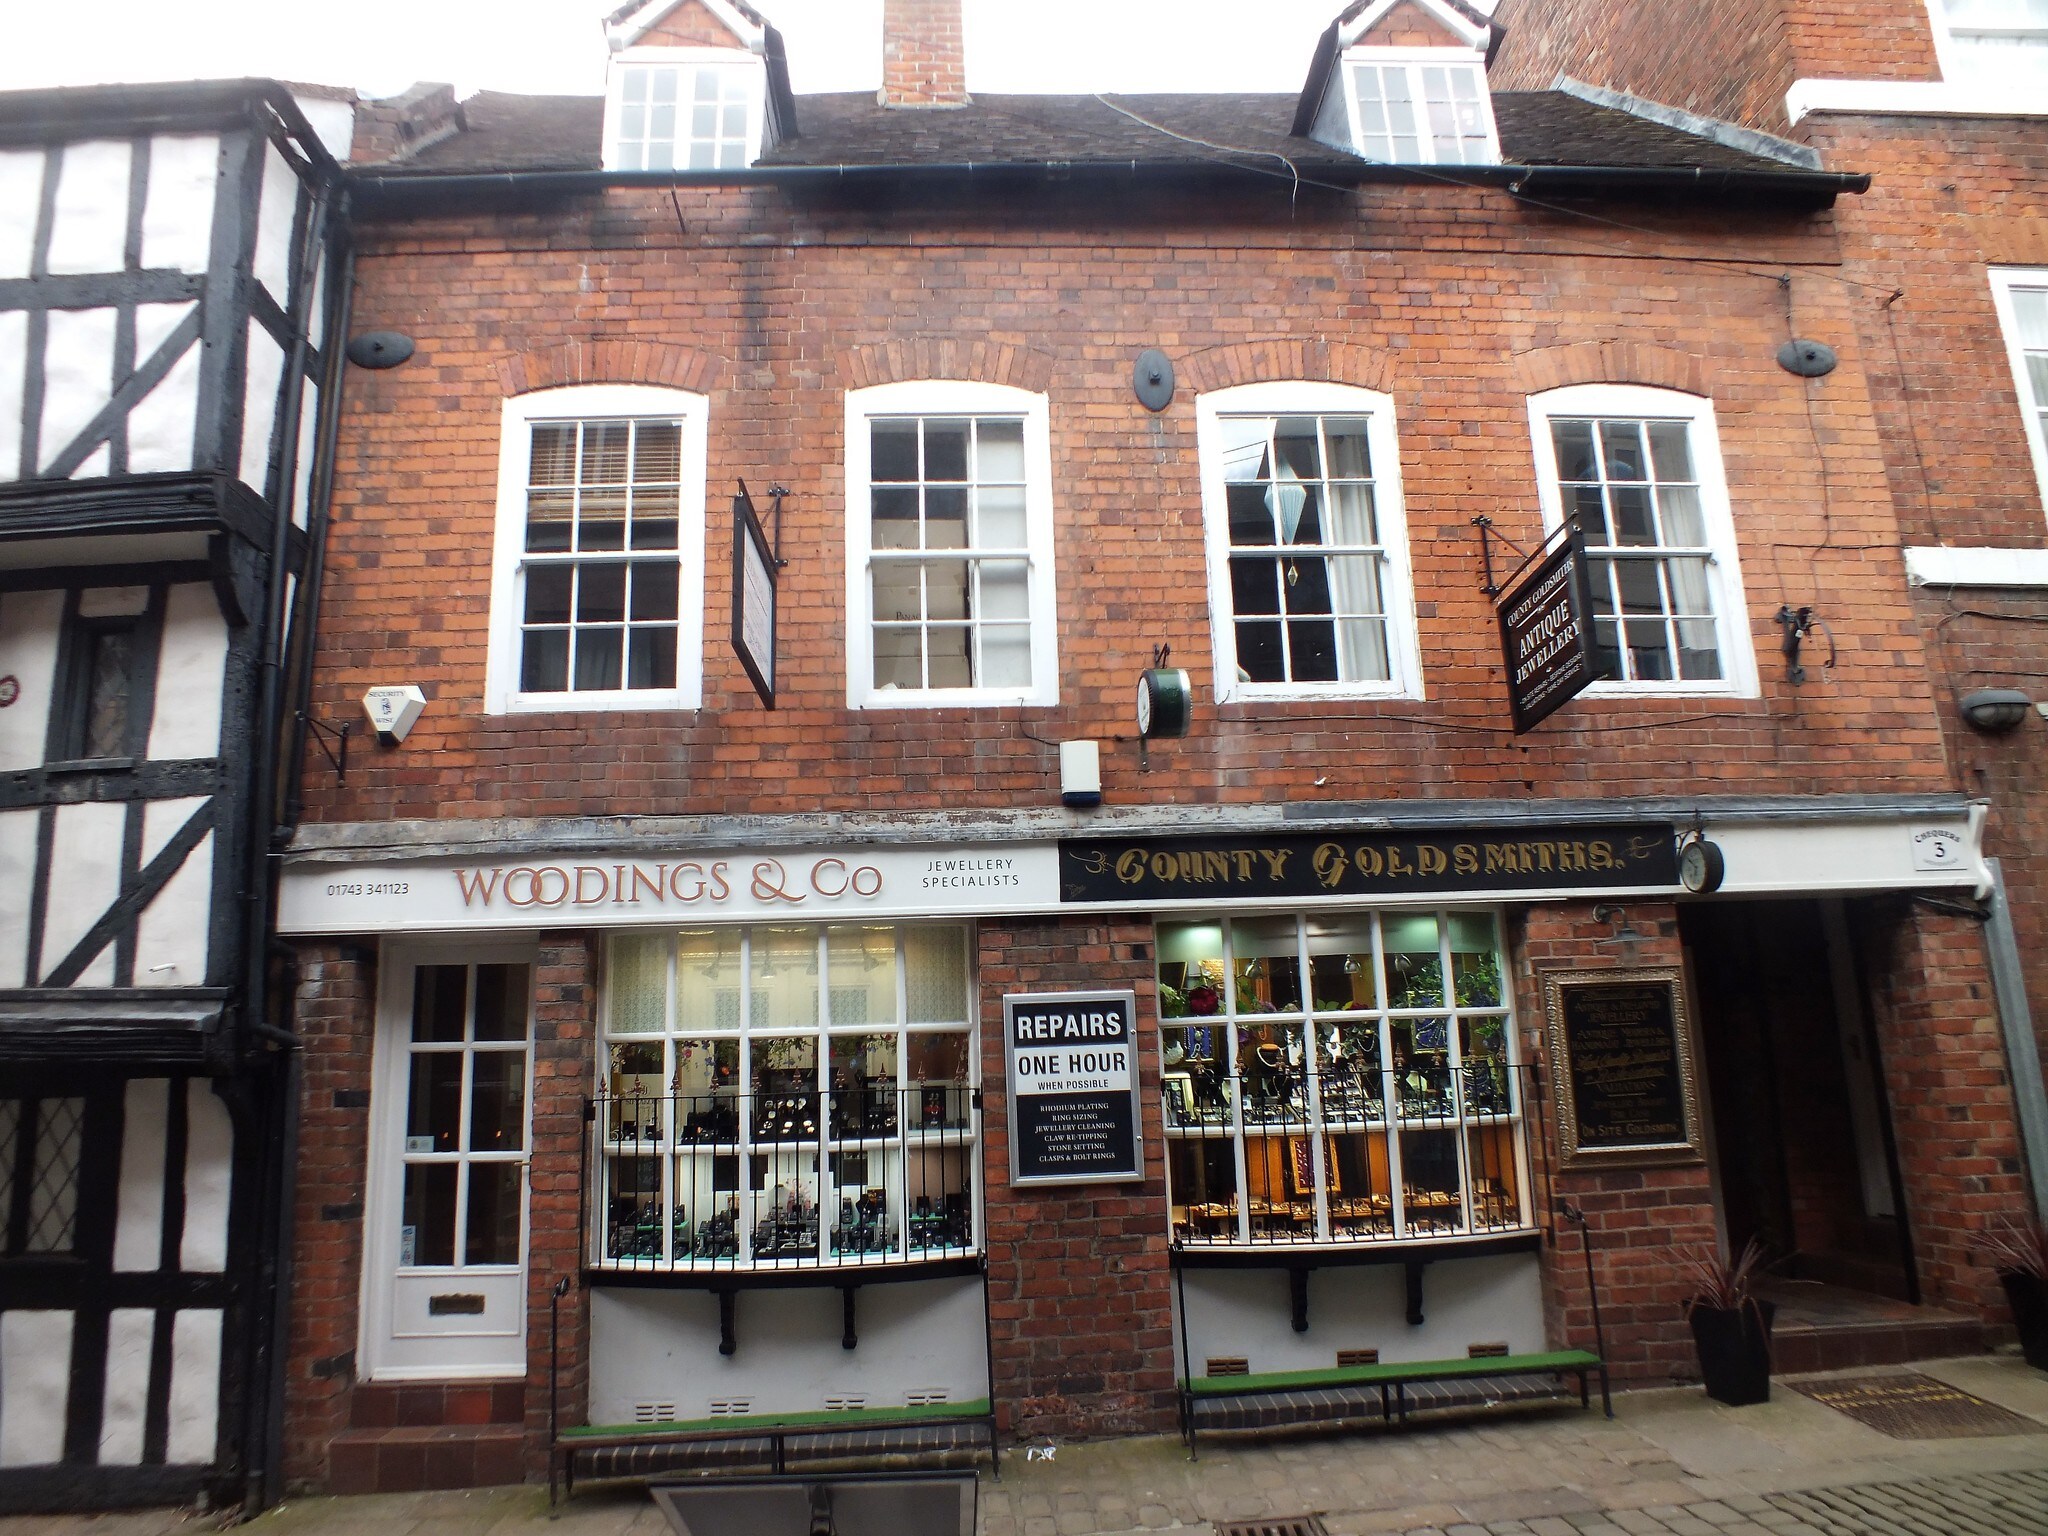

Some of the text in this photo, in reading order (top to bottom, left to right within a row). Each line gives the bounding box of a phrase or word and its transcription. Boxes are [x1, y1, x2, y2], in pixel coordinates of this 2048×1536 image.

[1507, 557, 1574, 627] COUNTY GOLDSMITHS
[1520, 599, 1570, 659] ANTIQUE
[1516, 617, 1581, 685] JEWELLERY
[368, 690, 405, 698] SECURITY
[1914, 829, 1961, 843] CHEQUERS
[1934, 842, 1945, 858] 3
[927, 858, 1013, 872] JEWELLERY
[1115, 846, 1293, 884] COUNTY
[452, 861, 731, 907] WOODINGS
[750, 857, 807, 902] &
[922, 874, 1020, 888] SPECIALISTS
[328, 883, 409, 896] 01743 341123
[1587, 1010, 1649, 1023] JEWELLERY
[1017, 1012, 1122, 1040] REPAIRS
[1018, 1052, 1127, 1076] ONE HOUR
[1037, 1079, 1109, 1091] WHEN POSSIBLE
[1040, 1102, 1109, 1113] RHODIUM PLATING
[1052, 1113, 1098, 1122] RING SIZING
[1034, 1122, 1116, 1133] JEWELLERY CLEANING
[1598, 1124, 1623, 1137] SITE
[1044, 1132, 1108, 1142] CLAW RE-TIPPING
[1047, 1143, 1105, 1152] STONE SETTING
[1039, 1151, 1116, 1163] CLASPS & BOLT RINGS
